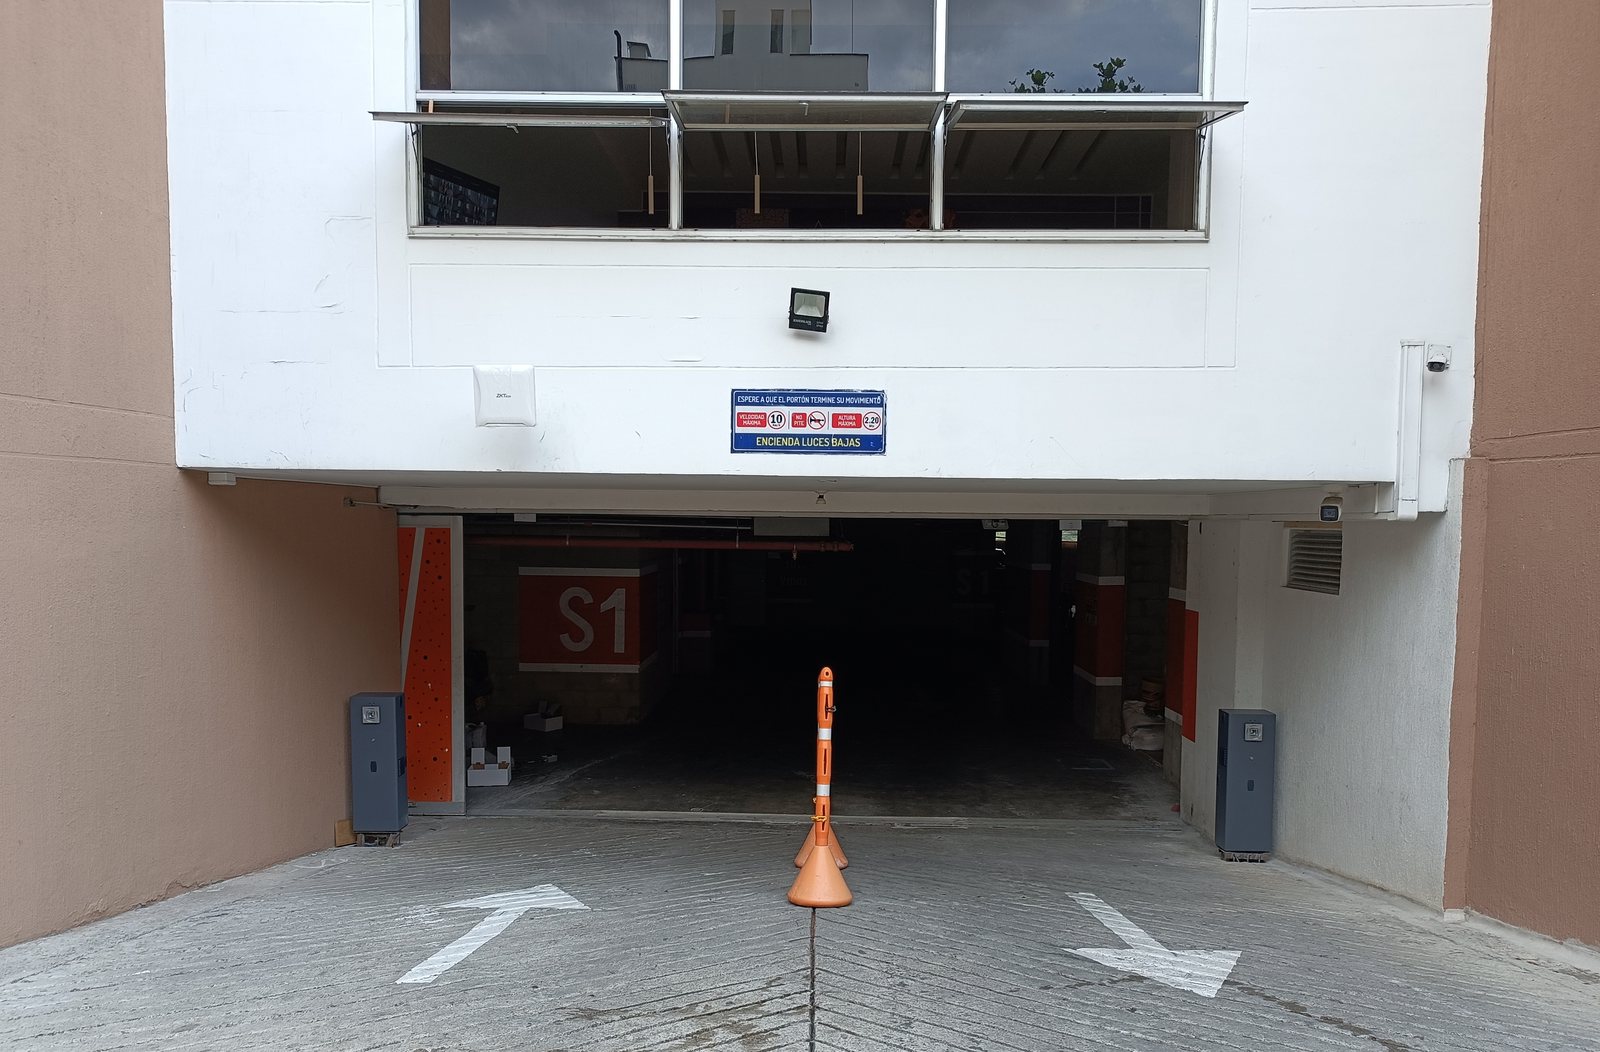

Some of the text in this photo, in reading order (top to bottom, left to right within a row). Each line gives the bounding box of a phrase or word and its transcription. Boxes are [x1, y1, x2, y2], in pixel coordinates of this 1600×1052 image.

[737, 395, 759, 403] ESPERE
[766, 396, 777, 404] QUE
[786, 395, 810, 404] PORTÓN
[810, 396, 836, 404] TERMINE
[845, 396, 881, 404] MOVIMIENTO
[770, 414, 783, 424] 10
[864, 416, 879, 425] 2.20
[756, 436, 861, 448] ENCIENDA LUCES BAJAS
[559, 586, 626, 653] S1
